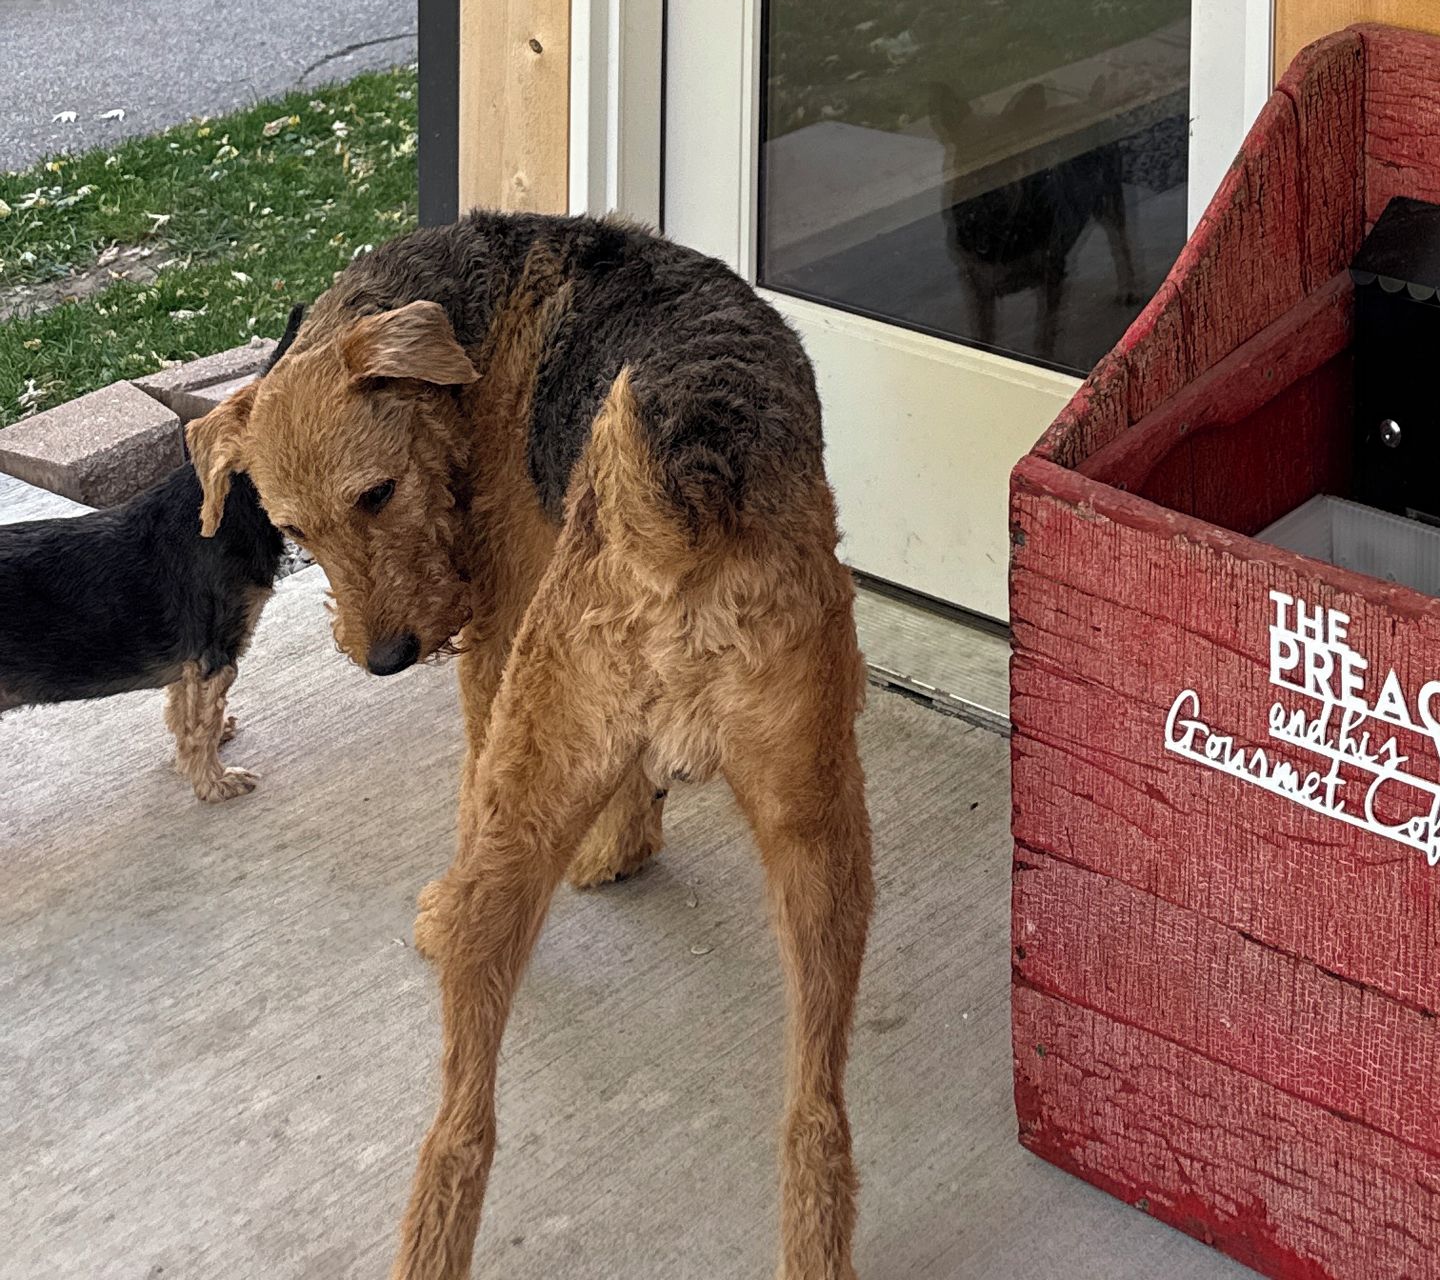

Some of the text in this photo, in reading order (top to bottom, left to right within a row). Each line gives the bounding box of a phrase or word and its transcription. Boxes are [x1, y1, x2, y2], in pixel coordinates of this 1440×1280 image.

[1269, 589, 1350, 646] THE
[1165, 689, 1347, 818] Gourmet
[1269, 702, 1333, 754] and
[1340, 702, 1409, 770] his
